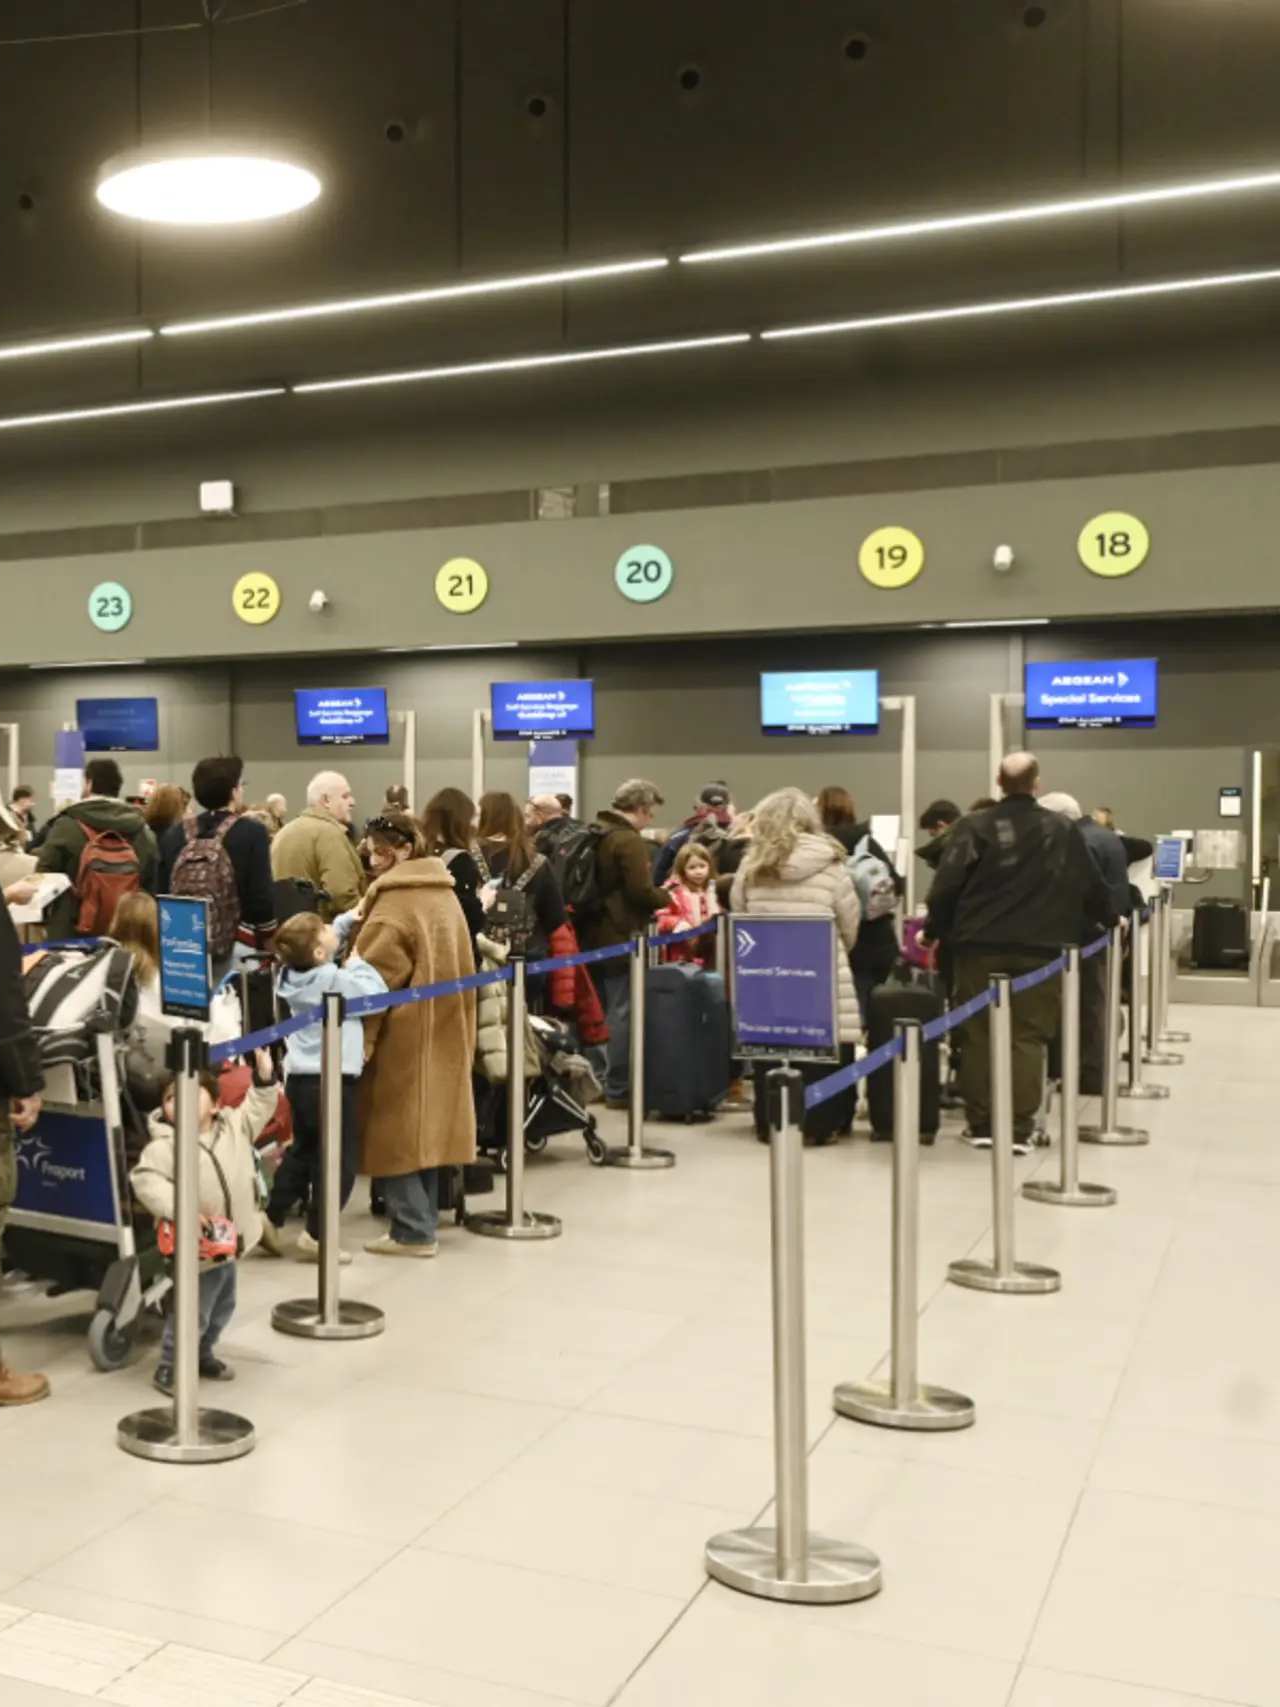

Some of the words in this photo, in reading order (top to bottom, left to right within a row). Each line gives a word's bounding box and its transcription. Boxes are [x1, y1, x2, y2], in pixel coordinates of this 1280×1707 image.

[1096, 531, 1132, 558] 18
[875, 545, 908, 569] 19
[626, 559, 662, 584] 20
[448, 574, 473, 597] 21
[96, 596, 124, 618] 23
[242, 587, 270, 610] 22
[1051, 675, 1115, 686] AEGEAN
[1040, 693, 1087, 707] Special
[1088, 693, 1141, 704] Services
[737, 966, 773, 977] Special
[775, 966, 817, 978] Services
[41, 1160, 86, 1181] Fraport
